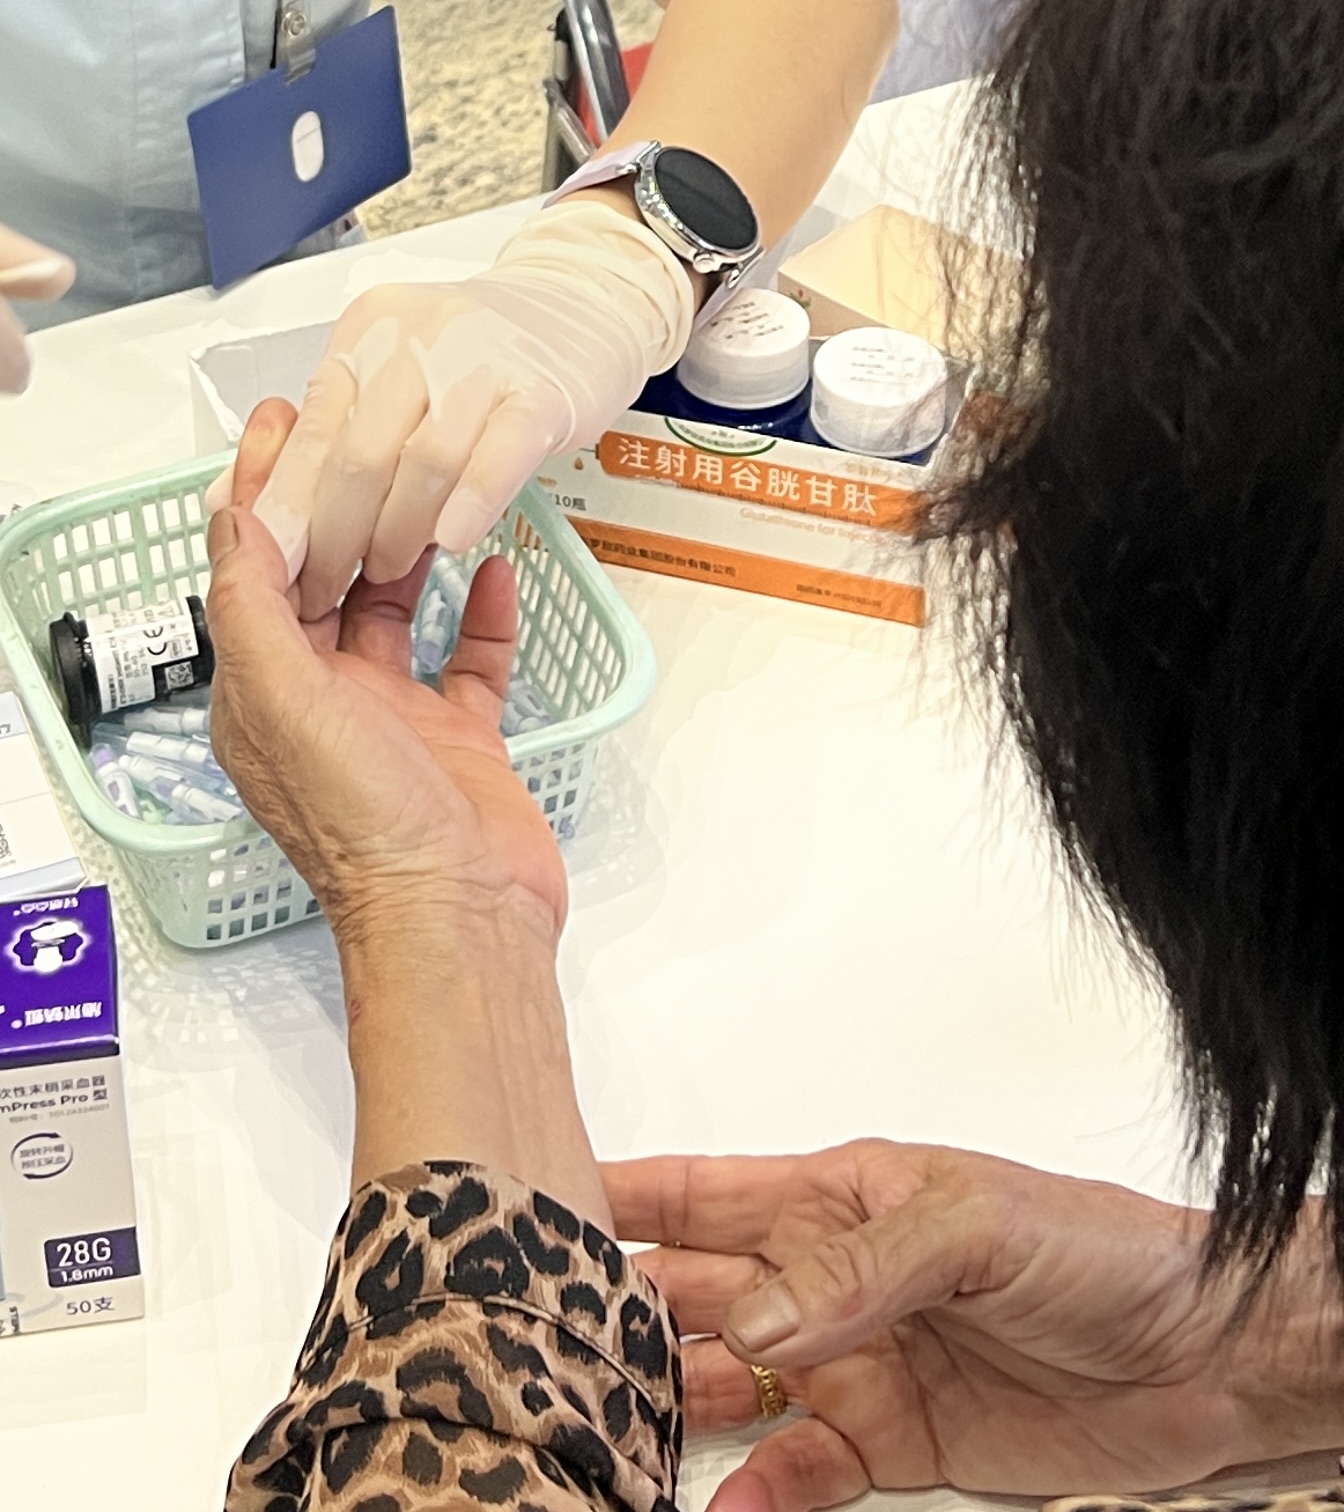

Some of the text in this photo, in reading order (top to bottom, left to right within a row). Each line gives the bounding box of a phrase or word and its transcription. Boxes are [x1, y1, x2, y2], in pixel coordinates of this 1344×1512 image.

[618, 437, 878, 517] 注射用谷胱甘肽
[60, 1092, 89, 1107] Pro
[56, 1236, 113, 1268] 28G
[59, 1263, 114, 1284] 1.8mm
[66, 1296, 116, 1316] 50支
